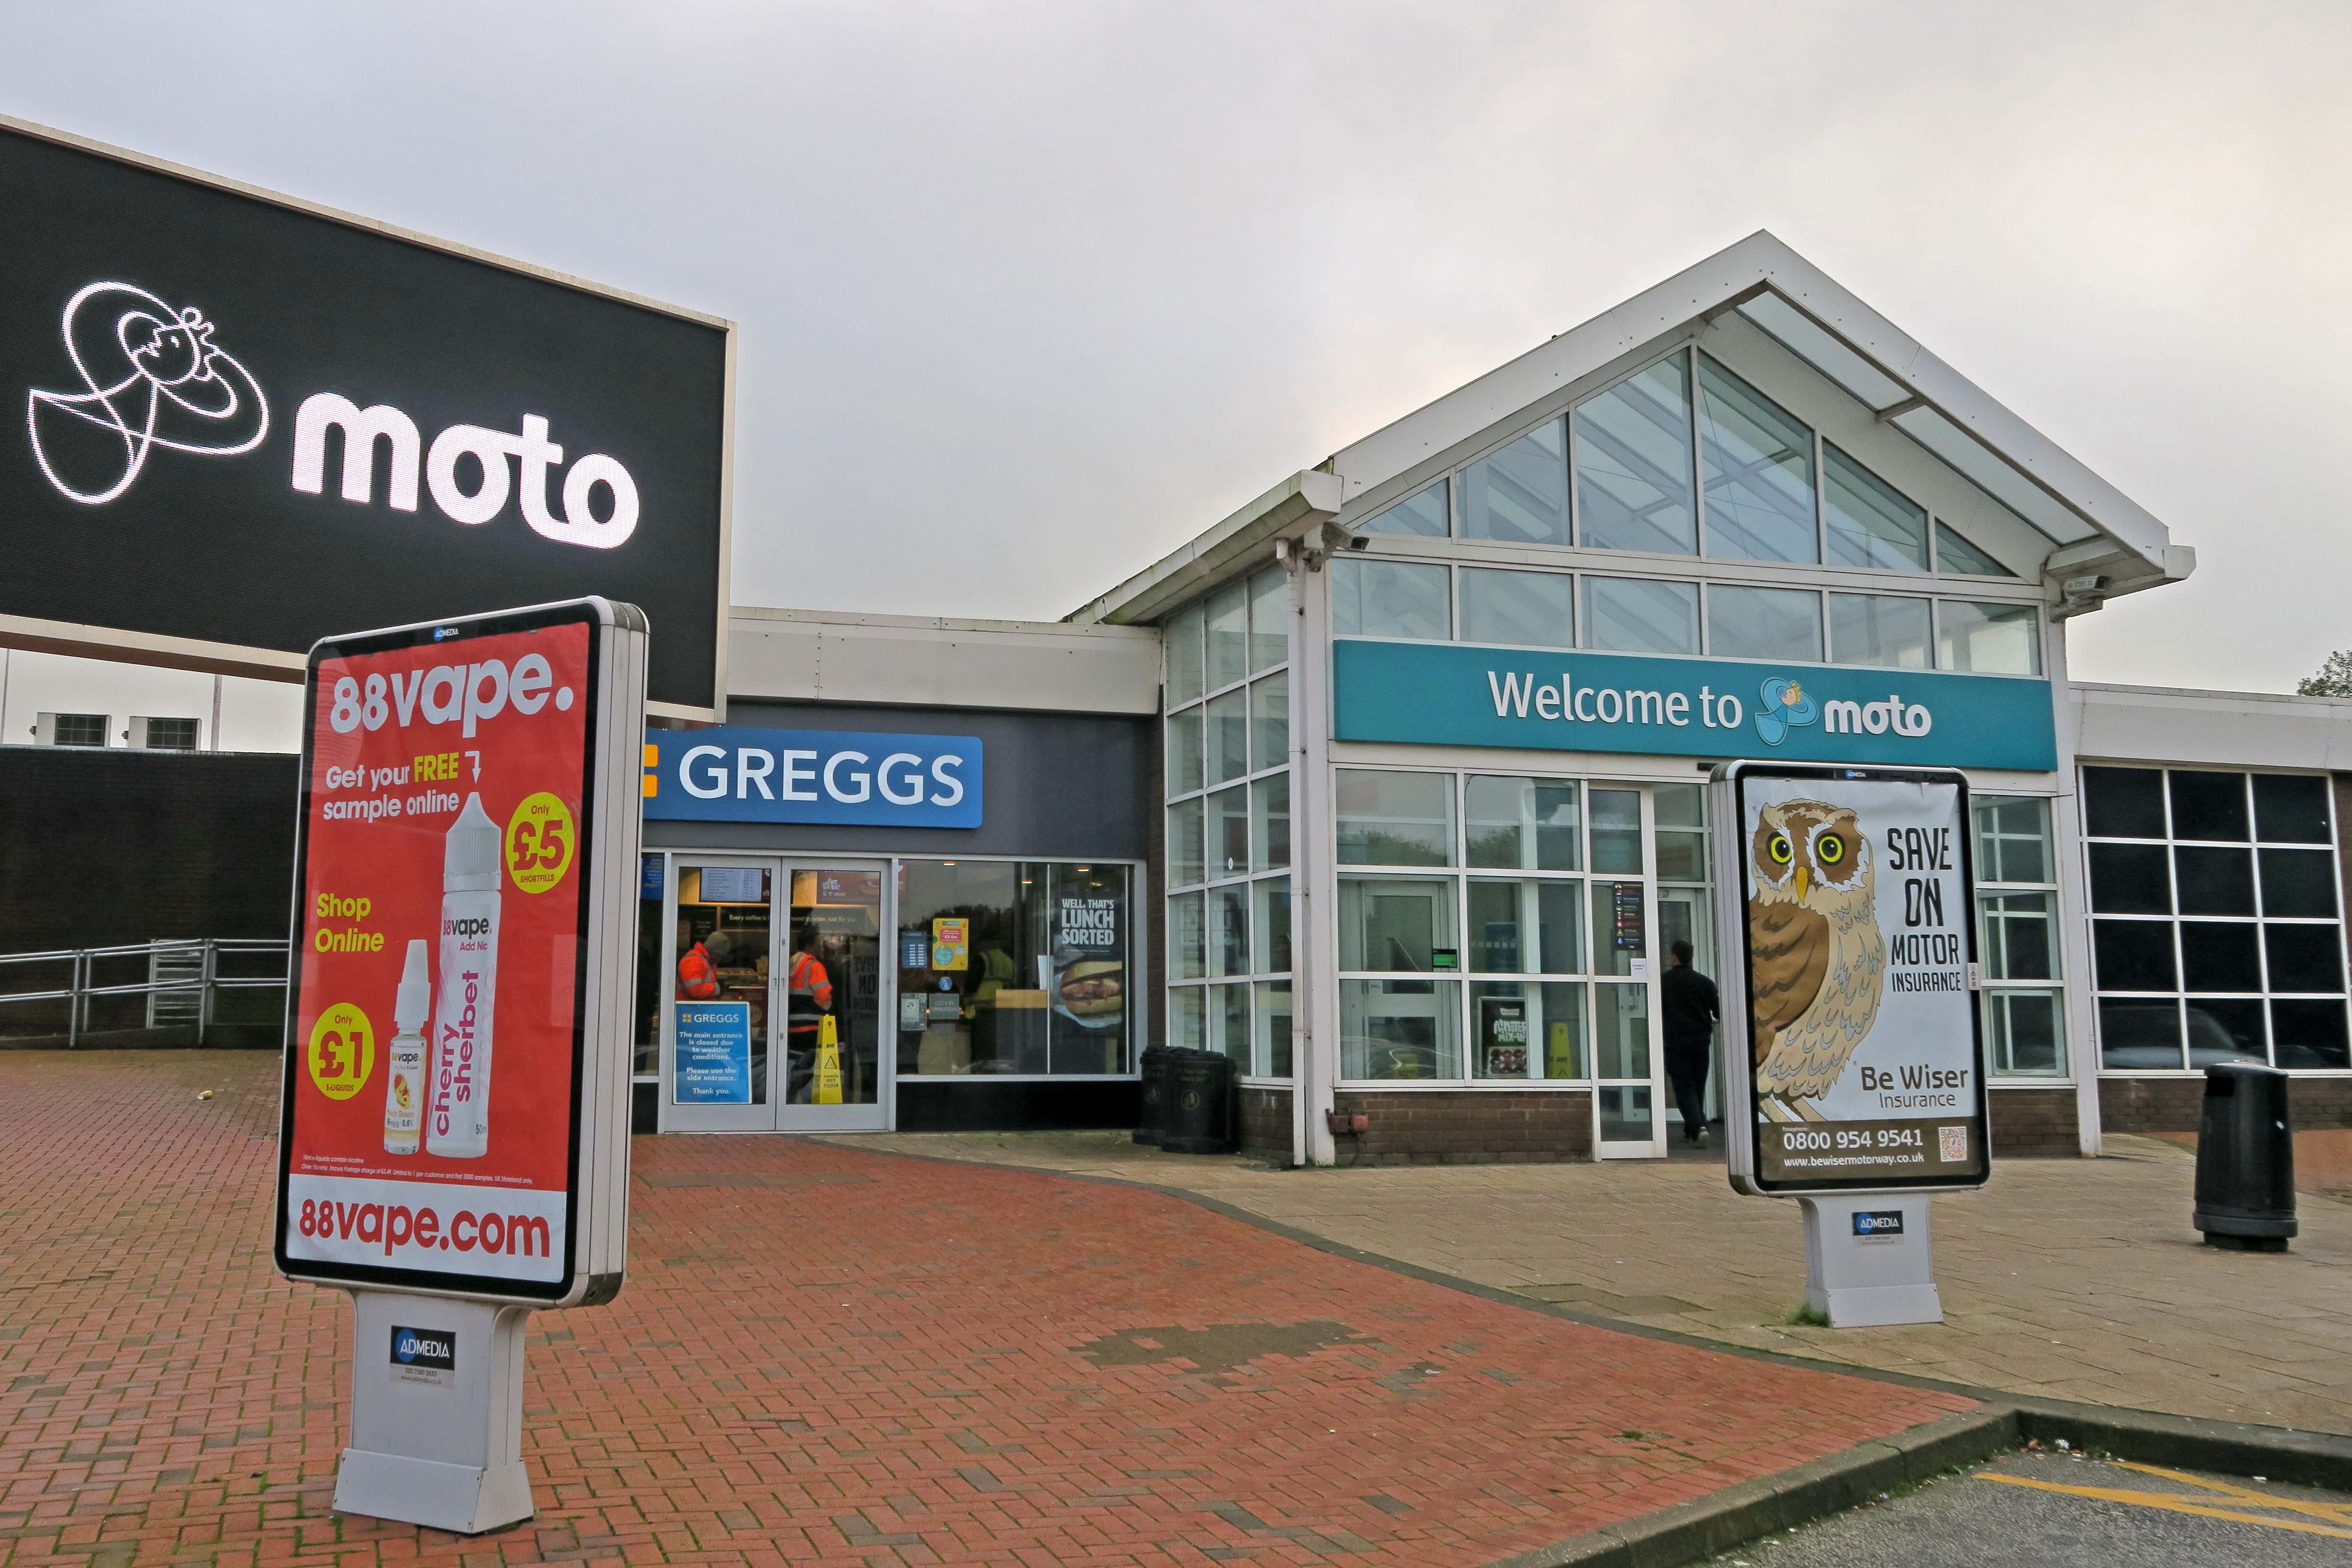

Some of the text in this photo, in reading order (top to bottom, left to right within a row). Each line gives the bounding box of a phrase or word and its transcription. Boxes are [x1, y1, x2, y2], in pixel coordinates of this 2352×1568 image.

[291, 392, 640, 549] moto
[330, 653, 574, 738] 88vape.
[1487, 671, 1932, 737] Welcome to moto
[325, 752, 459, 792] Get your FREE
[679, 744, 964, 807] GREGGS
[324, 789, 460, 823] sample online
[530, 804, 550, 817] Only
[513, 819, 565, 871] £5
[1887, 827, 1952, 871] SAVE
[520, 873, 555, 883] SHORTFILLS
[316, 892, 371, 921] Shop
[1087, 899, 1114, 909] THAT'S
[1904, 878, 1944, 927] ON
[443, 918, 492, 940] 88vape.
[1062, 909, 1114, 929] LUNCH
[315, 927, 385, 953] Online
[460, 941, 488, 951] Add Nic
[1062, 929, 1114, 945] SORTED
[1891, 933, 1960, 966] MOTOR
[1892, 971, 1961, 993] INSURANCE
[334, 1014, 353, 1026] Only
[694, 1014, 739, 1023] GREGGS
[453, 969, 479, 1102] sherbet
[319, 1030, 364, 1079] £1
[326, 1083, 354, 1092] E-LIQUIDS
[434, 1023, 460, 1136] cherry
[1861, 1065, 1969, 1091] Be Wiser
[1879, 1092, 1956, 1109] Insurance
[1784, 1129, 1923, 1150] 0800 954 9541
[1784, 1152, 1925, 1167] www.bewisermotorway.co.uk
[299, 1198, 550, 1258] 88vape.com
[1860, 1217, 1900, 1228] ADMEDIA
[400, 1338, 450, 1358] ADMEDIA
